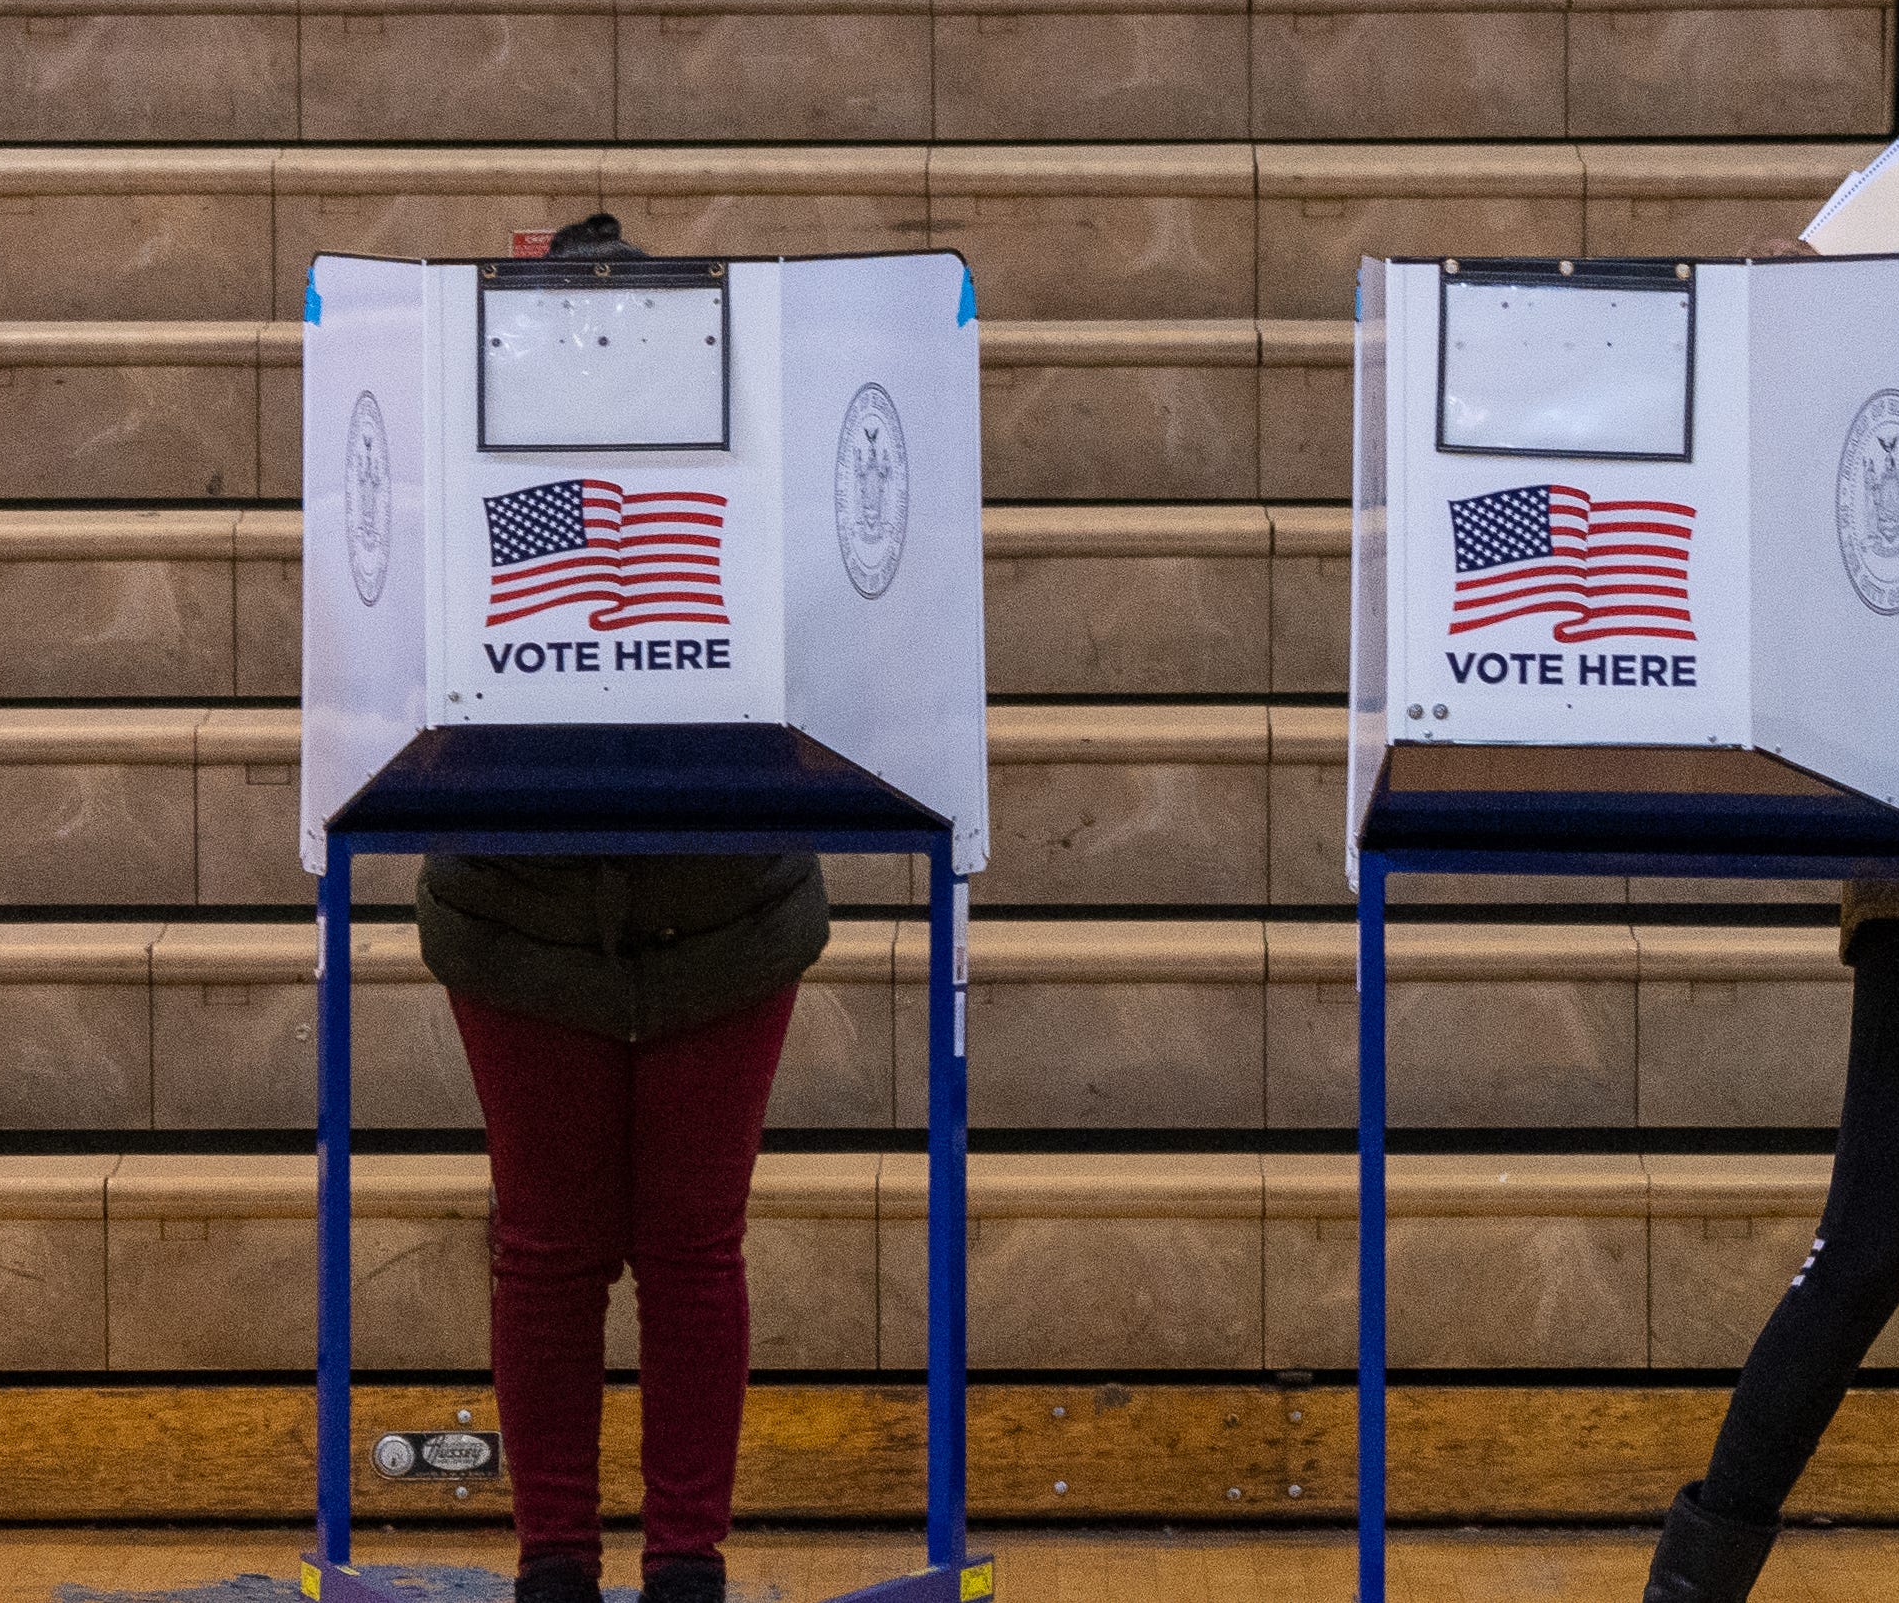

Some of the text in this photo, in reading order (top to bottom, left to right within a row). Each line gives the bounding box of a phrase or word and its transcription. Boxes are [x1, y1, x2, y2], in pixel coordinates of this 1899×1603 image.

[483, 638, 732, 674] VOTE HERE
[1445, 652, 1698, 688] VOTE HERE
